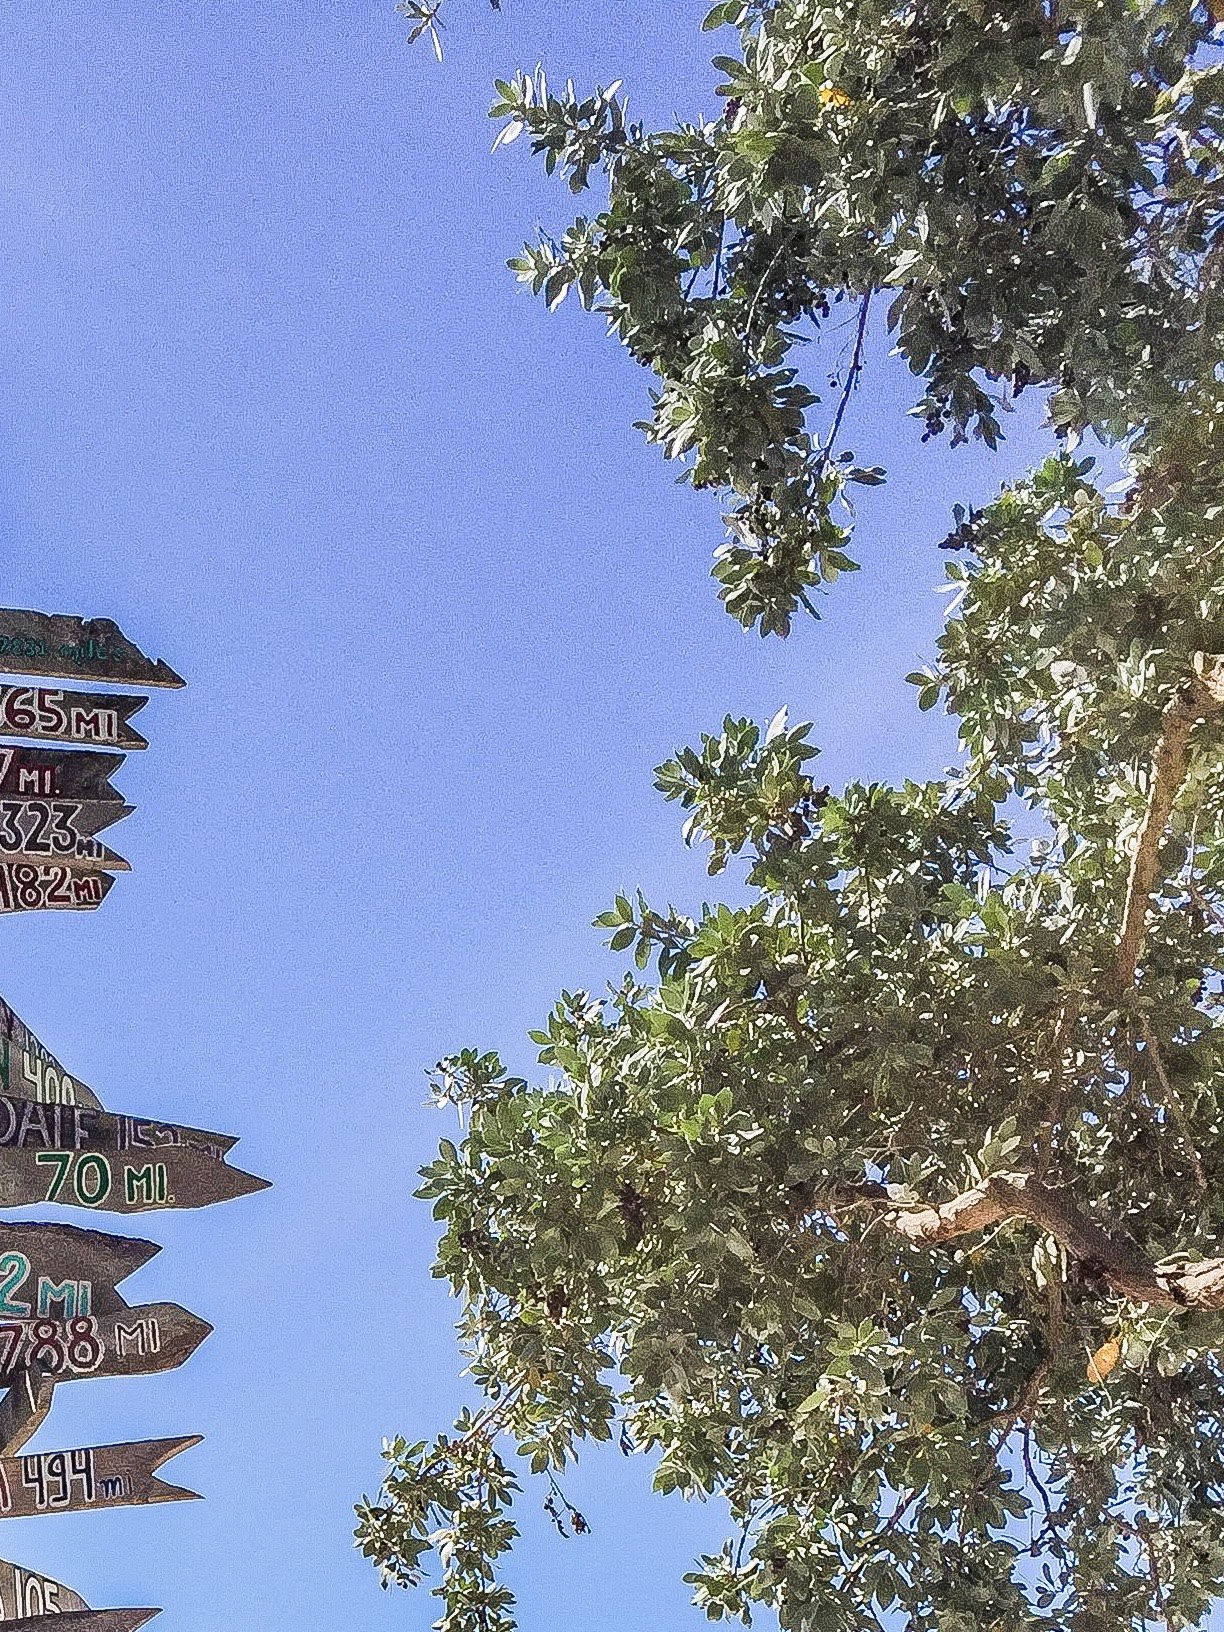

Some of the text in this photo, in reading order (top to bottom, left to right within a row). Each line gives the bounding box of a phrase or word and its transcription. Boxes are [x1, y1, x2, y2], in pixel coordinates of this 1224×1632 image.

[70, 876, 102, 906] MI
[35, 1150, 113, 1207] 70
[36, 1277, 94, 1320] MI
[114, 1318, 162, 1357] MI
[22, 1448, 96, 1509] 494
